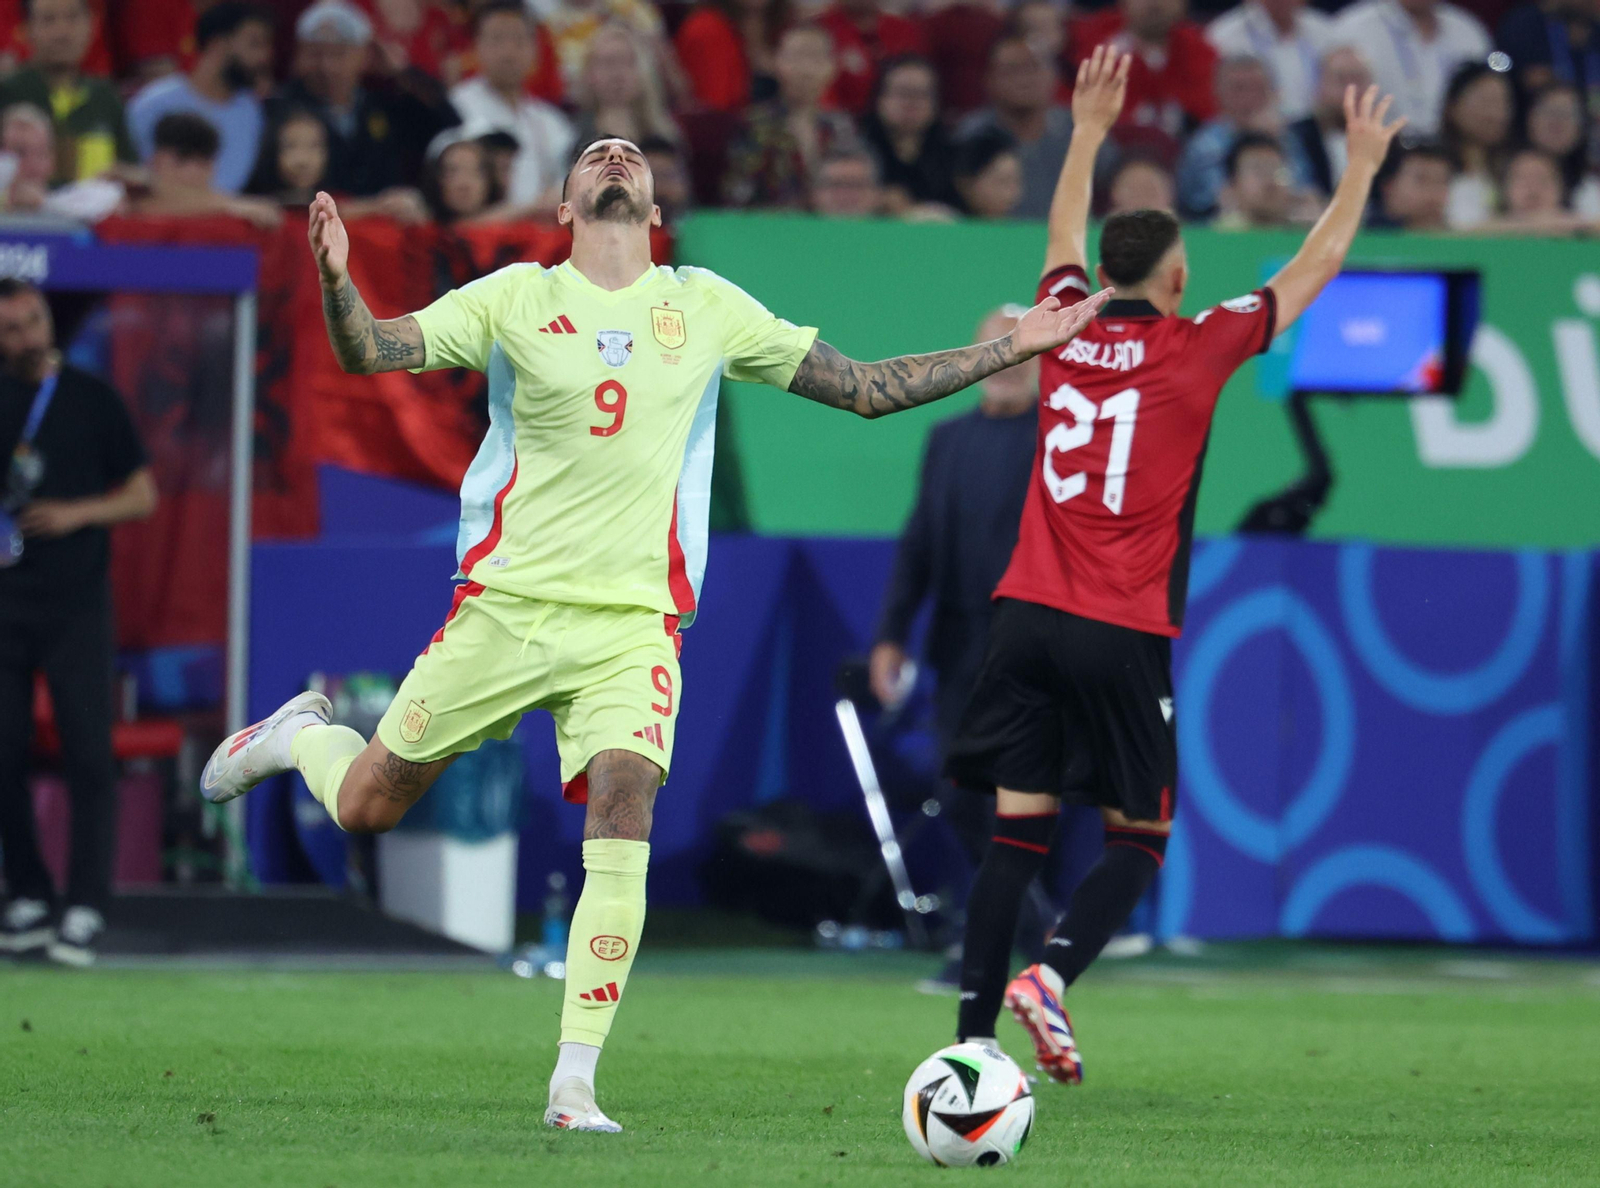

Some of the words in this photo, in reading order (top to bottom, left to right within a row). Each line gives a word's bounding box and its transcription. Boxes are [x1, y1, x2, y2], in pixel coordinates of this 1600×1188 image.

[1058, 337, 1145, 371] ASLLANI
[590, 379, 628, 437] 9
[1043, 383, 1141, 516] 21
[651, 665, 672, 717] 9
